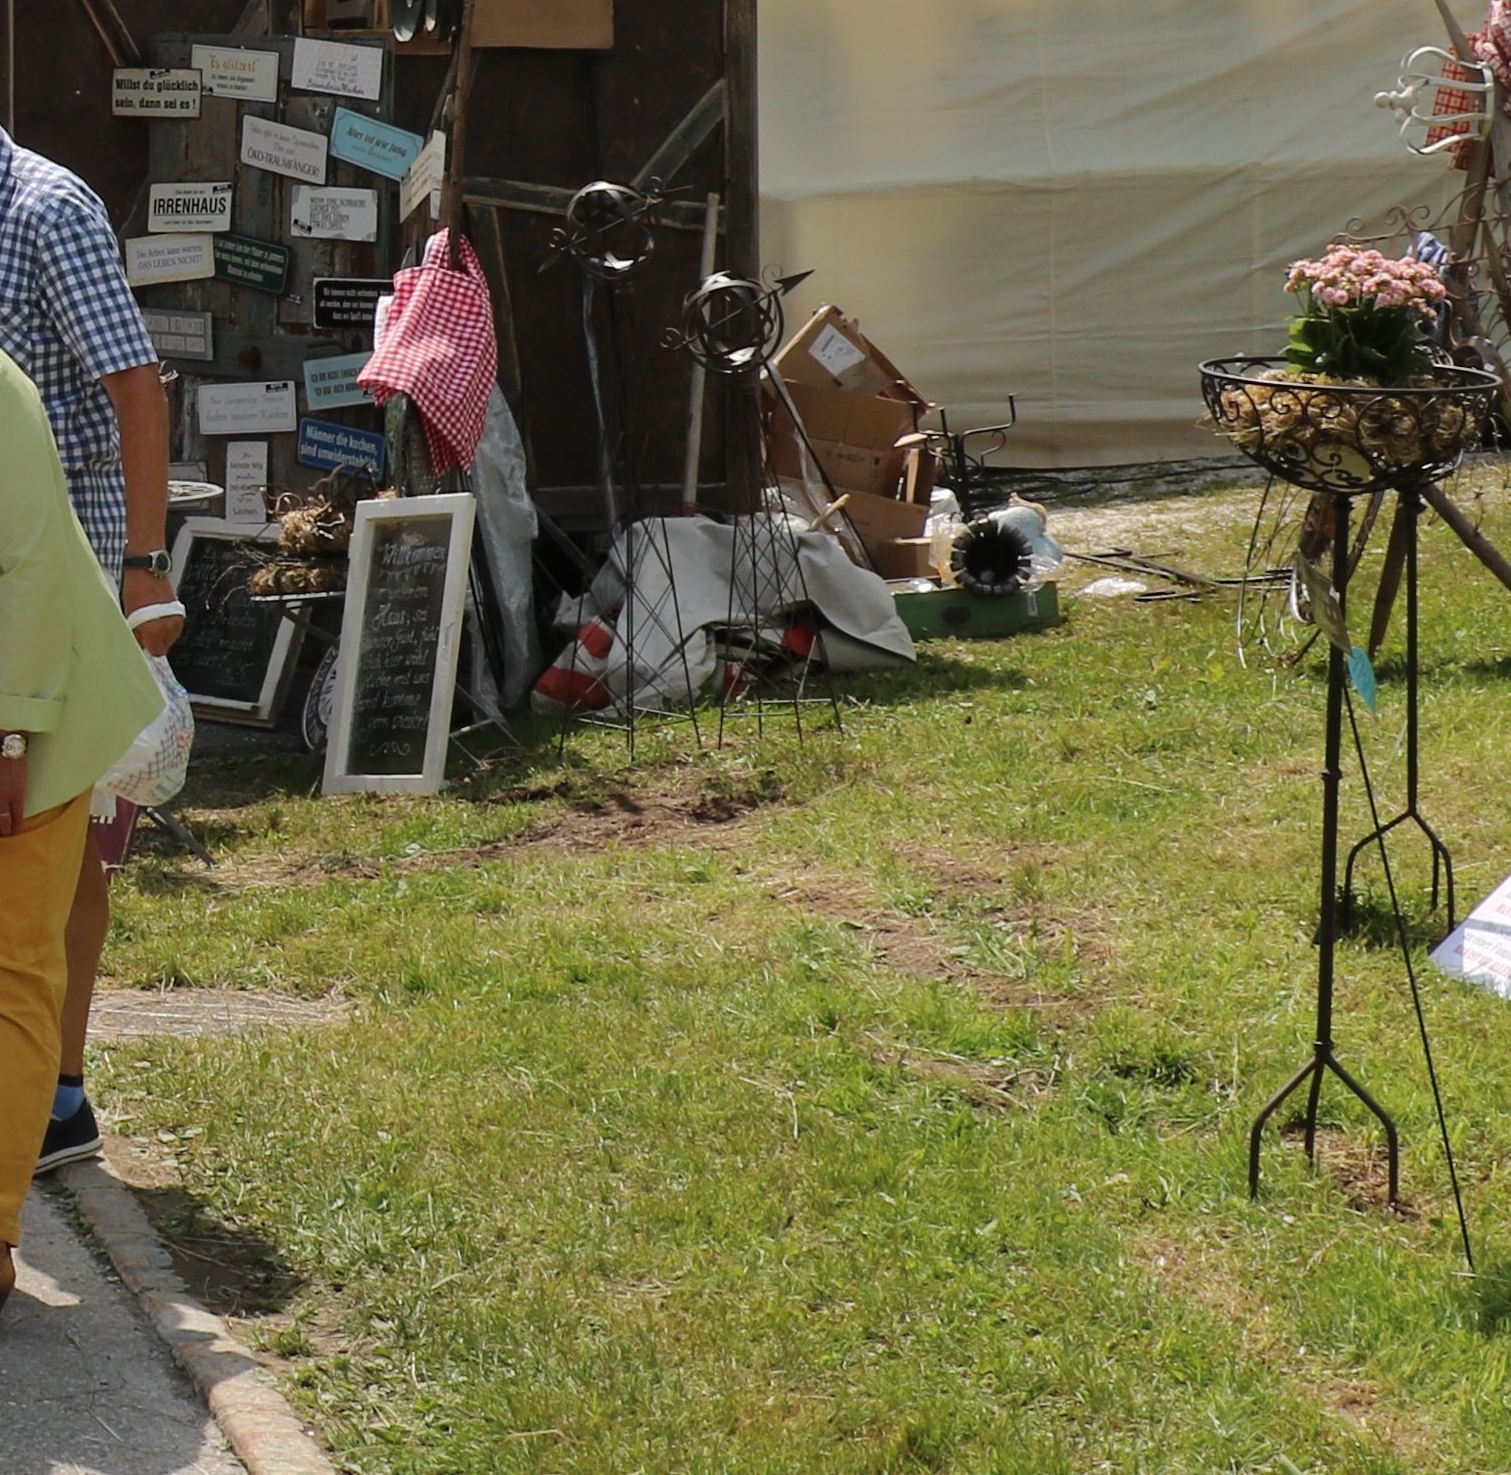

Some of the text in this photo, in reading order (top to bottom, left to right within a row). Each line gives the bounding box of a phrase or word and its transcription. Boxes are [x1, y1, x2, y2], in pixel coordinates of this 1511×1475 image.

[115, 79, 199, 93] Willst du glücklich
[139, 97, 161, 109] dann
[164, 98, 177, 109] sei
[179, 100, 190, 109] es
[153, 196, 227, 214] IRRENHAUS
[306, 425, 377, 456] Männer die kochen,
[301, 442, 317, 457] sind
[382, 543, 446, 565] Willkommen
